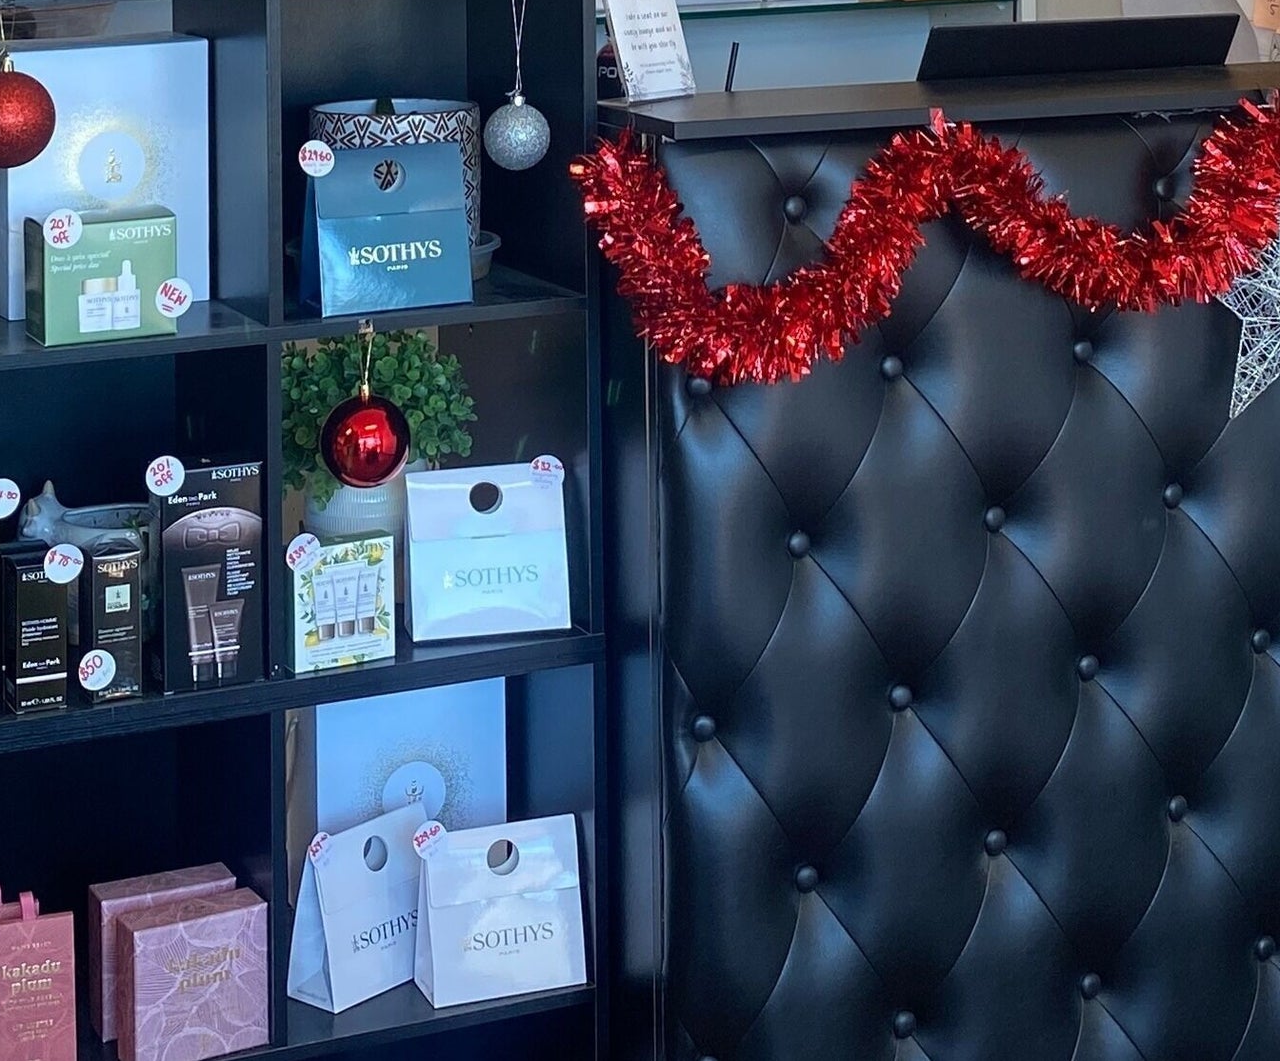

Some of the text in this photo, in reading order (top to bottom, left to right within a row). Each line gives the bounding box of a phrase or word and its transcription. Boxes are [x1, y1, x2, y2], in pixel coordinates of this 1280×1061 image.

[1270, 4, 1279, 16] 5
[50, 215, 74, 230] 20%
[53, 230, 69, 244] off
[117, 224, 171, 240] SOTHYS
[361, 240, 442, 265] SOTHYS
[160, 283, 187, 306] NEW
[155, 471, 173, 487] off
[217, 466, 259, 479] SOTHYS
[168, 491, 217, 505] Eden Park
[98, 559, 138, 573] SOTHYS
[191, 572, 216, 580] SOTHYS
[455, 564, 538, 588] SOTHYS
[22, 657, 60, 669] Eden Park
[79, 654, 103, 681] $50
[360, 909, 418, 949] SOTHYS
[473, 922, 554, 951] SOTHYS
[1, 959, 61, 979] kakadu
[170, 947, 240, 974] kakadu
[12, 978, 52, 997] plum
[180, 969, 231, 994] plum
